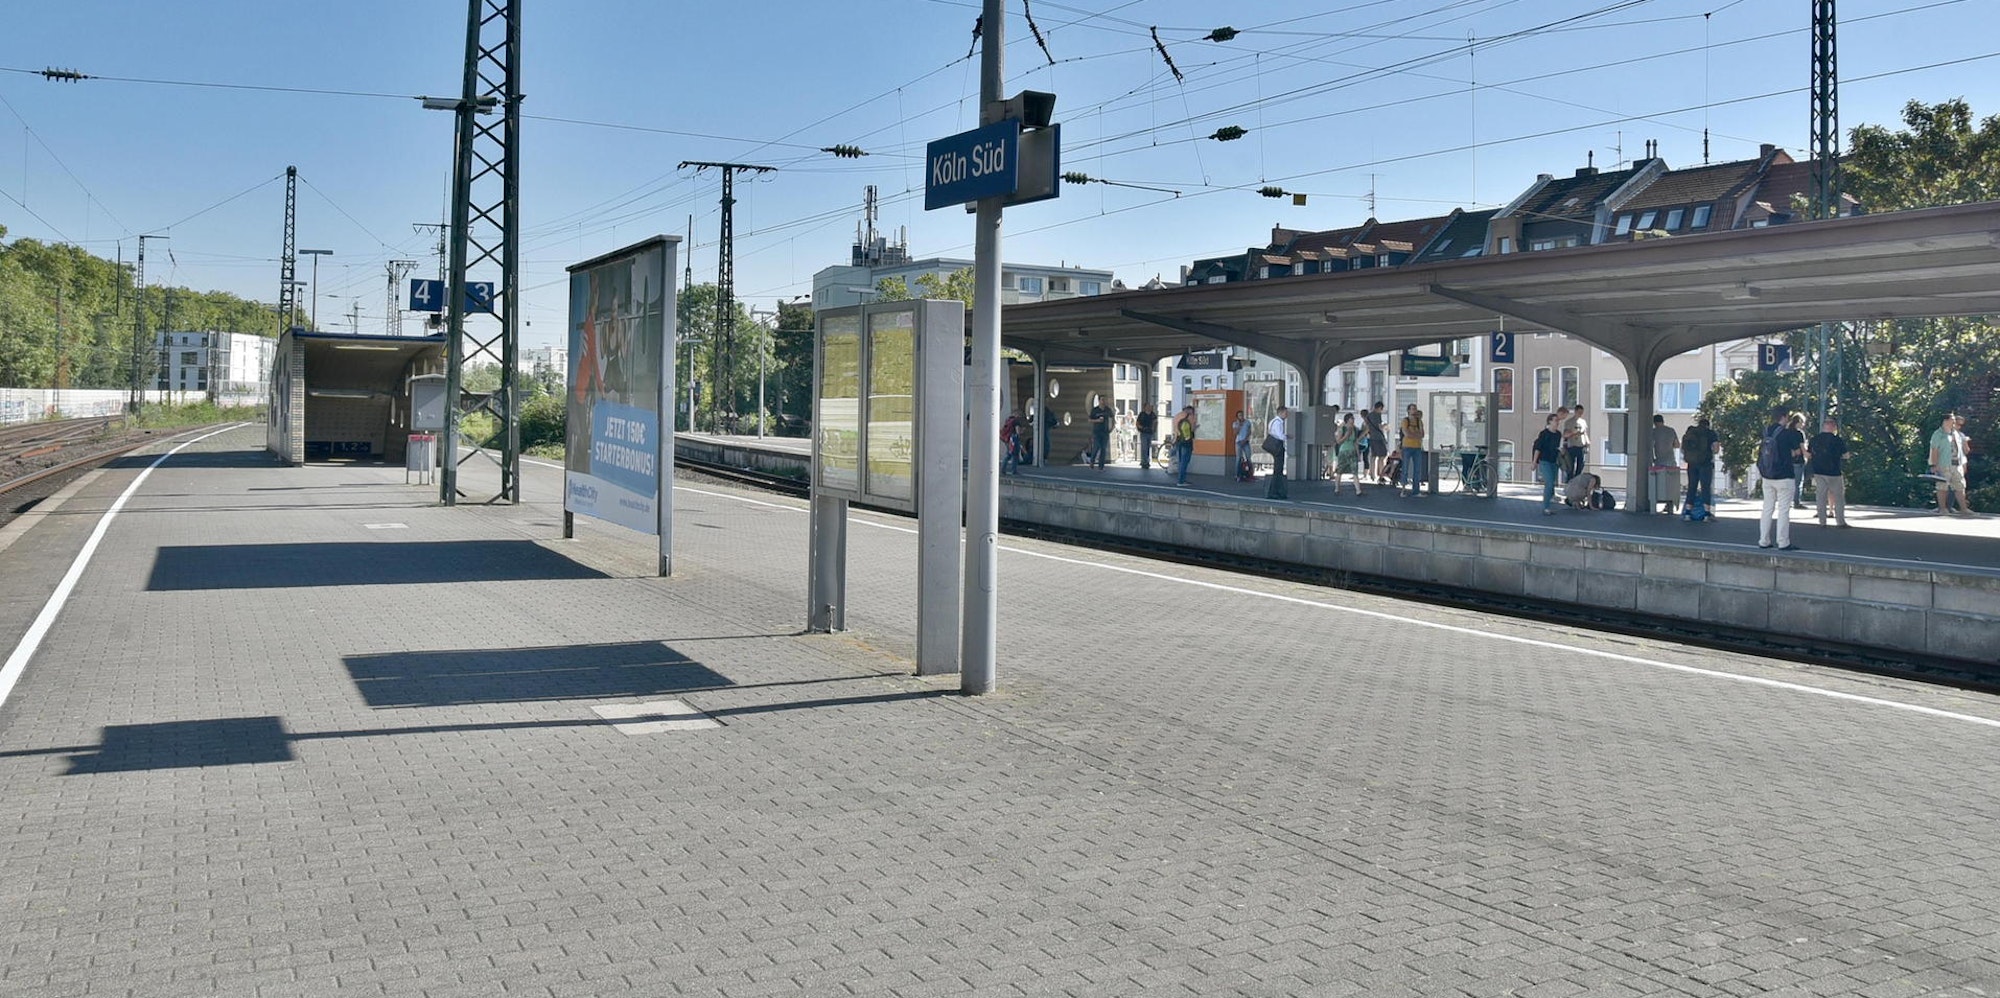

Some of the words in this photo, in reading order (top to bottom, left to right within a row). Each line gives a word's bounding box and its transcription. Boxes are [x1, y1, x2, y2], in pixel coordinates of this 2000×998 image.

[932, 151, 967, 187] Köln
[972, 138, 1006, 178] Süd
[414, 280, 431, 304] 4
[474, 283, 490, 307] 3
[1494, 333, 1507, 357] 2
[1765, 345, 1776, 365] B
[604, 415, 626, 440] JETZT
[627, 420, 646, 445] 150€
[351, 442, 358, 451] 2
[595, 441, 654, 477] STARTERBONUS!
